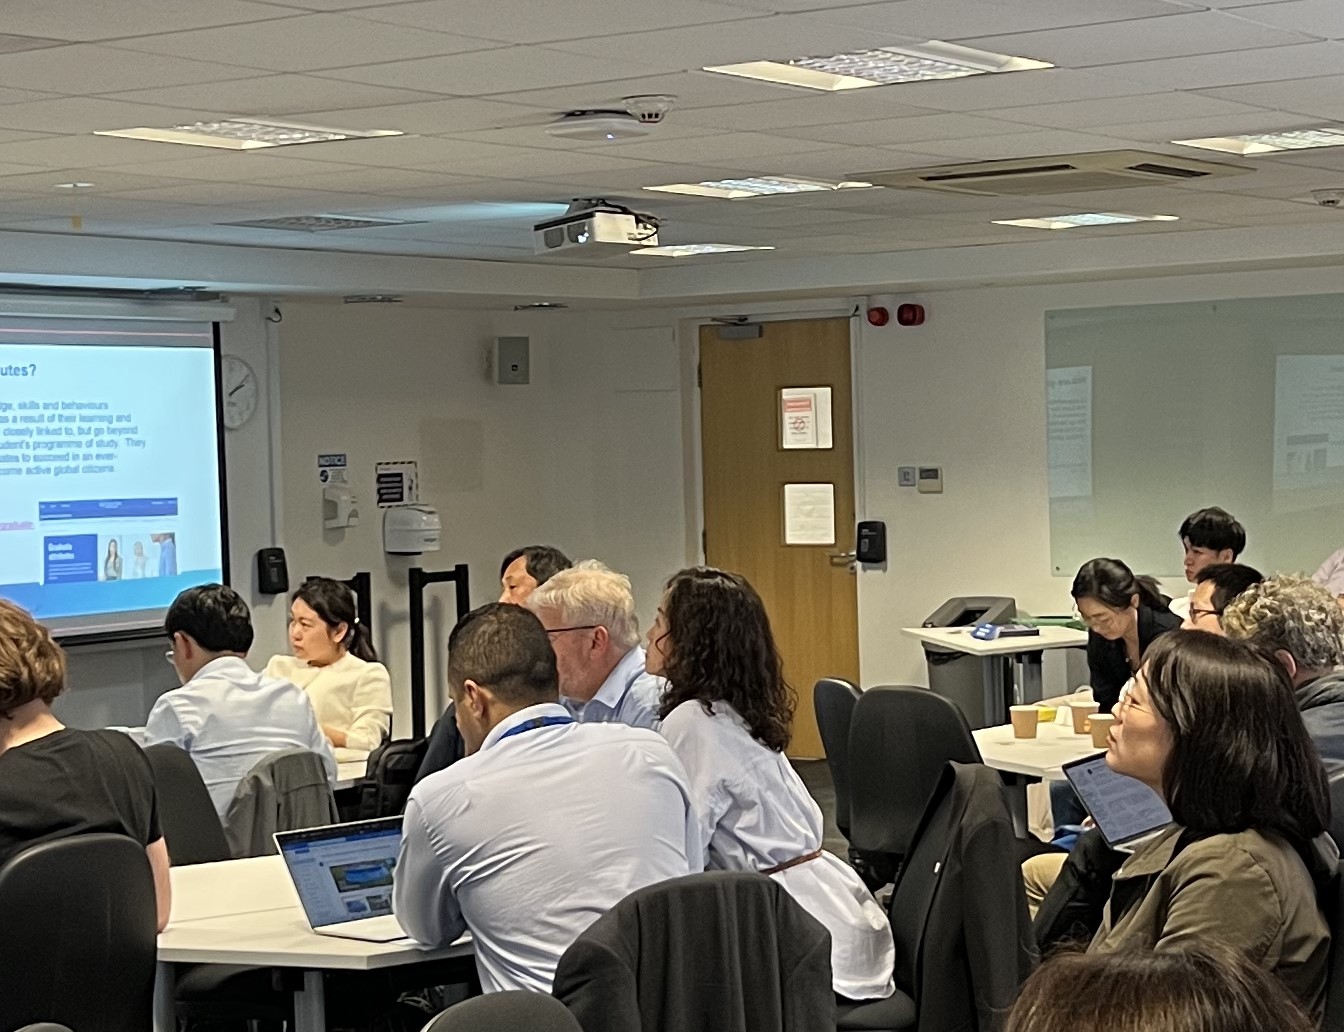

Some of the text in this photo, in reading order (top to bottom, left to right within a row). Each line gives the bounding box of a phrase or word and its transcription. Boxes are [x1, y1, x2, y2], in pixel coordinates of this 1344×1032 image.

[47, 414, 56, 423] of
[77, 426, 91, 435] but
[94, 428, 104, 437] go
[85, 438, 93, 448] of
[125, 437, 146, 448] They
[22, 453, 31, 462] to
